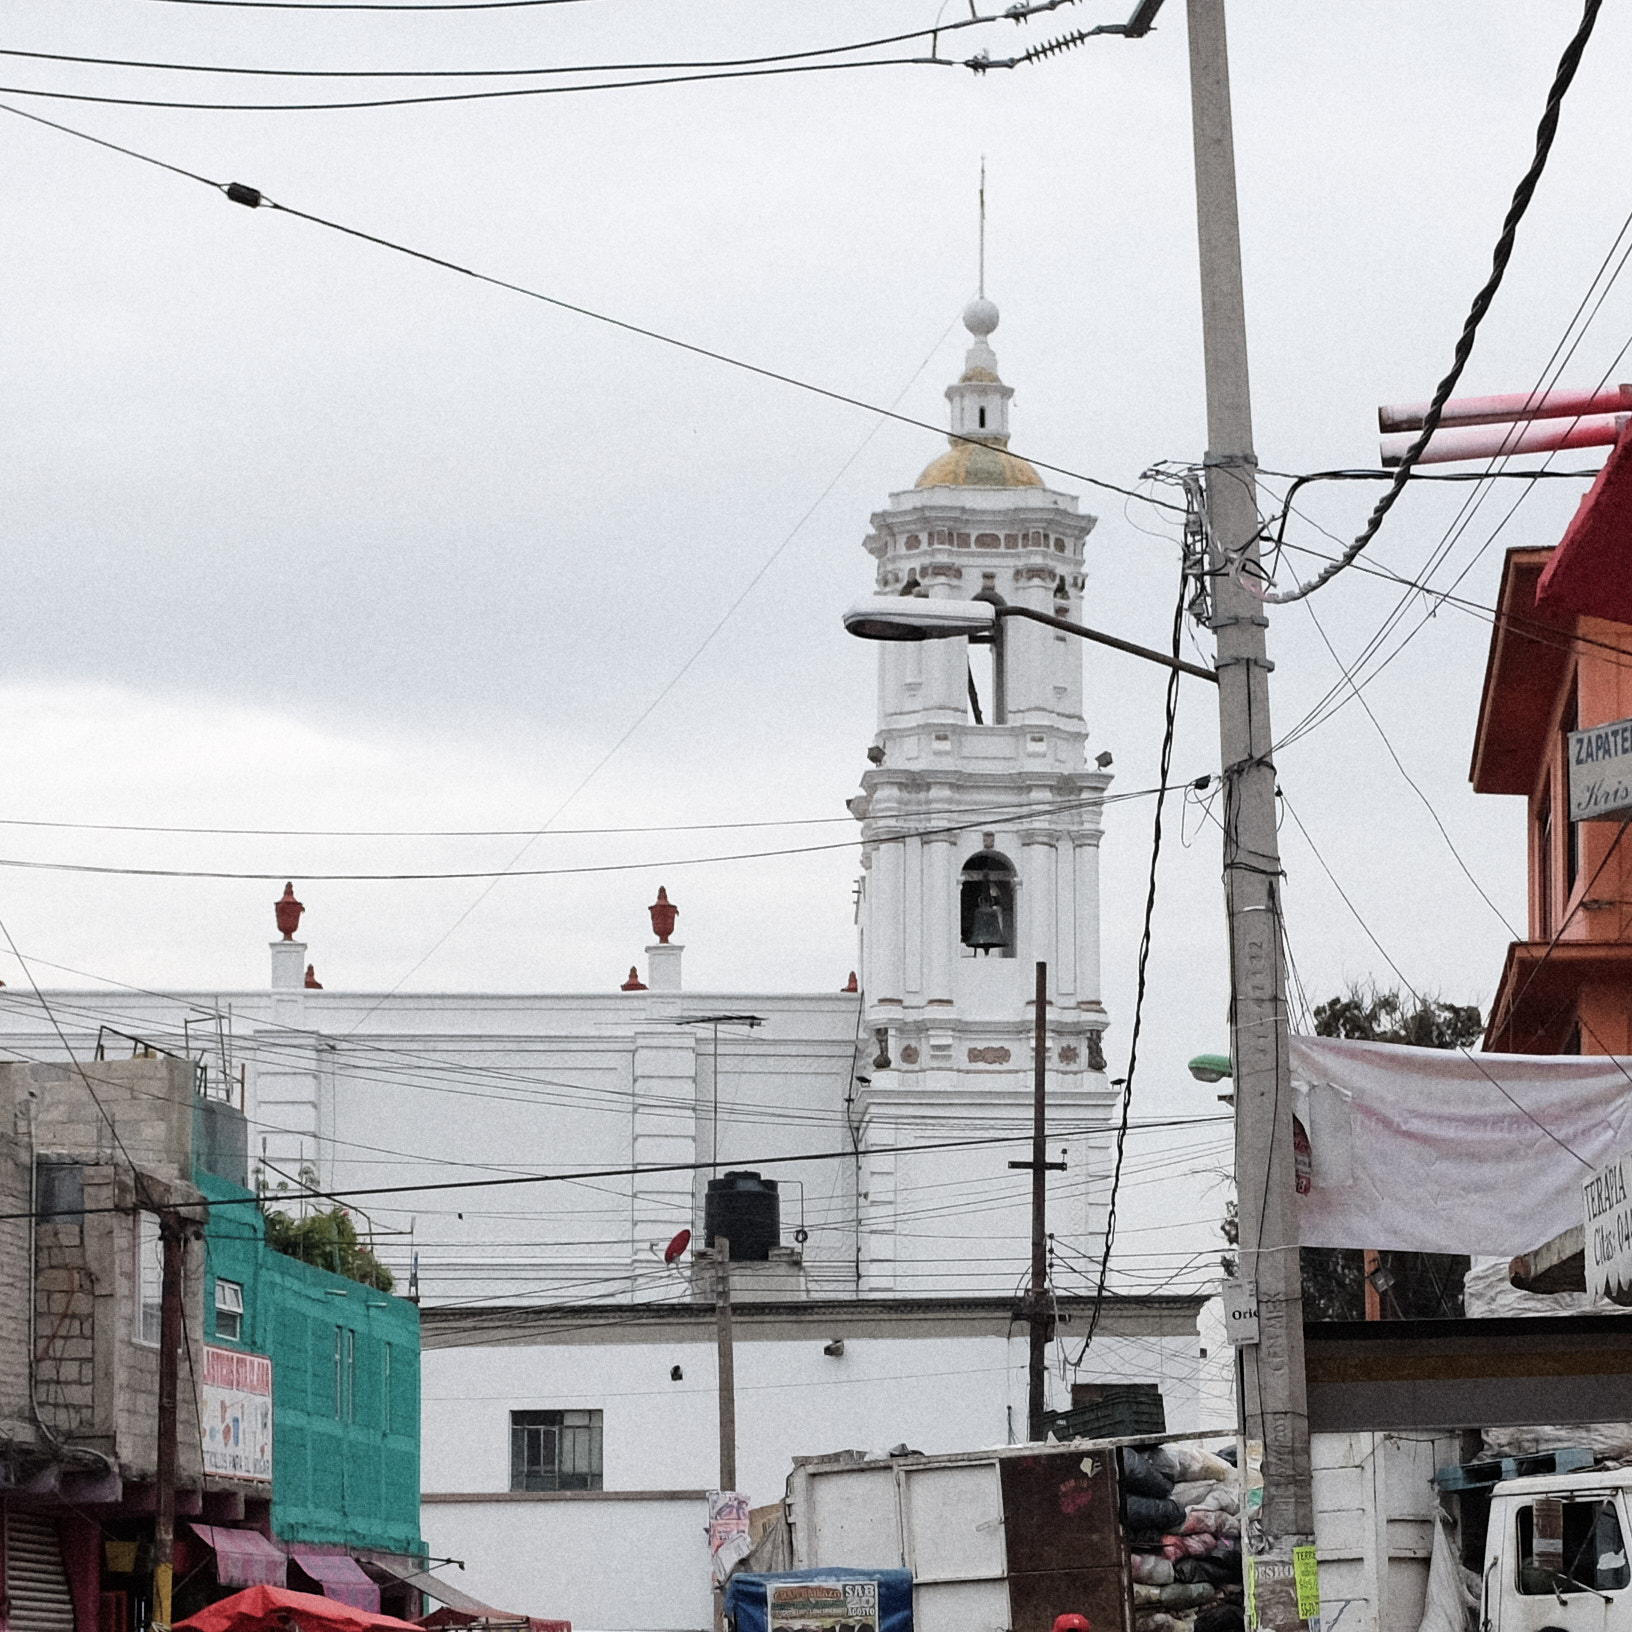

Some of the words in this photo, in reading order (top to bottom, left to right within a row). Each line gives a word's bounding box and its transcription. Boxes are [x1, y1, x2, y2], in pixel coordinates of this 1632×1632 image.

[1583, 1160, 1627, 1222] TERAPIA
[845, 1584, 875, 1597] SAB
[848, 1607, 875, 1616] AGOSTO
